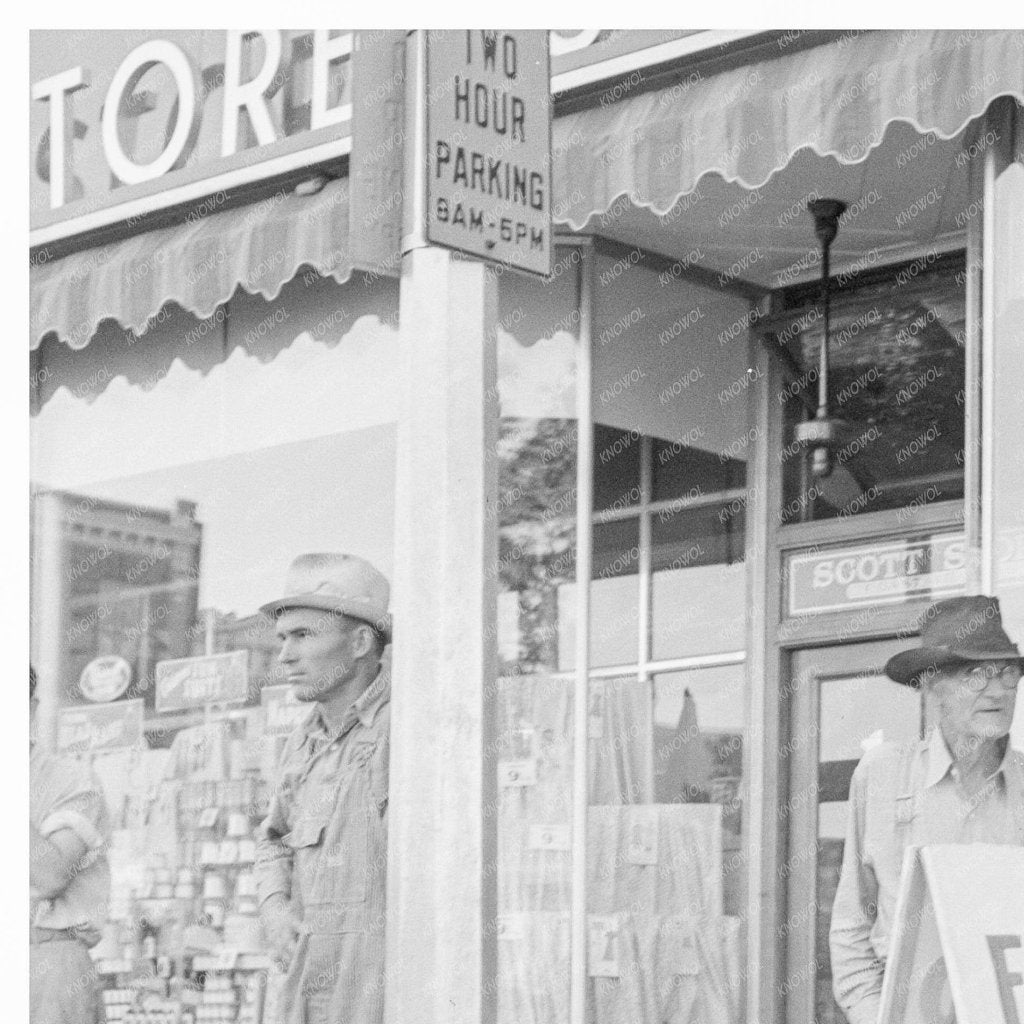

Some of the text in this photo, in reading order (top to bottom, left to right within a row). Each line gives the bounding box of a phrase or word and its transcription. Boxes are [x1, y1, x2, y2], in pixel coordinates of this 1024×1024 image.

[454, 75, 526, 143] HOUR
[436, 140, 544, 211] PARKING
[813, 548, 924, 589] SCOTT
